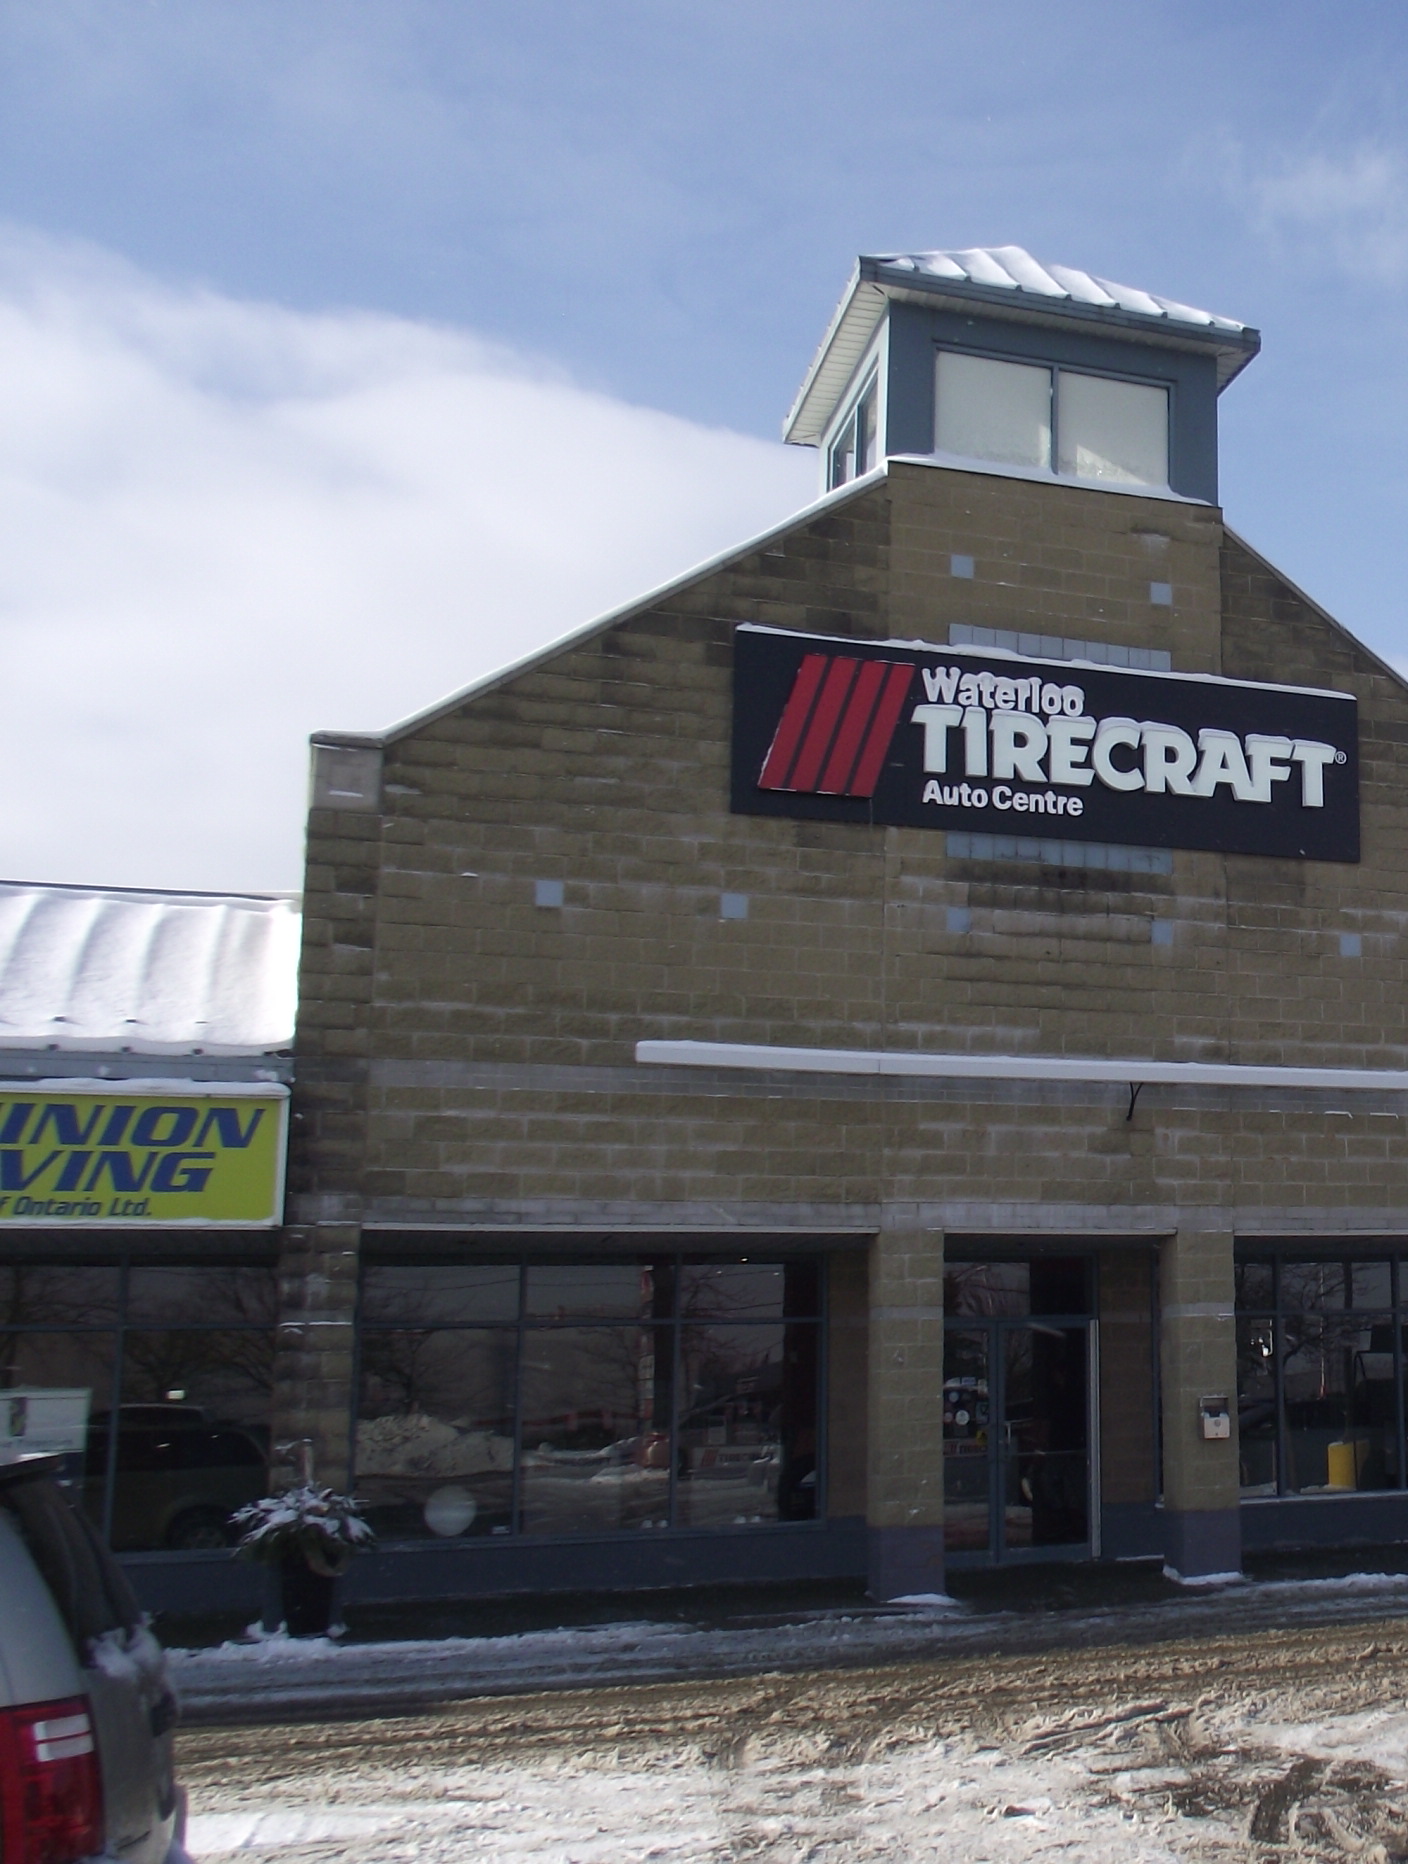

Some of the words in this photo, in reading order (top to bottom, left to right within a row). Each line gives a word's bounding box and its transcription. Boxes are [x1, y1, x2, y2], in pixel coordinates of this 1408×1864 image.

[922, 667, 1085, 717] Waterloo
[911, 704, 1337, 808] TIRECRAFT
[922, 779, 989, 809] Auto
[992, 785, 1084, 817] Centre
[13, 1195, 103, 1217] Ontario
[108, 1196, 153, 1217] Ltd.
